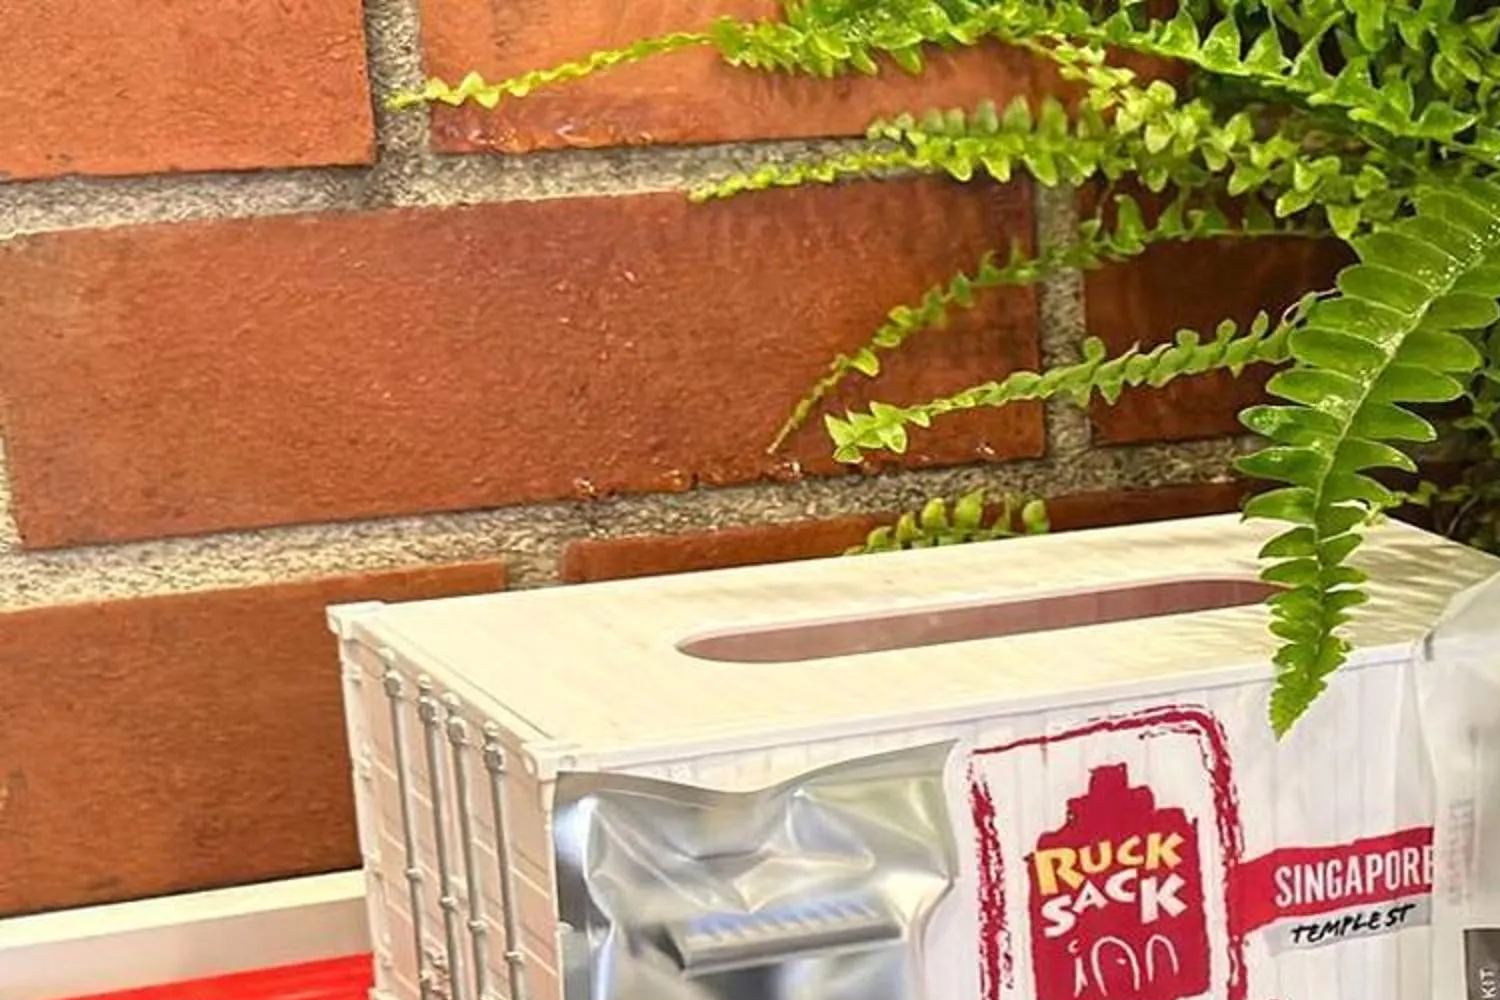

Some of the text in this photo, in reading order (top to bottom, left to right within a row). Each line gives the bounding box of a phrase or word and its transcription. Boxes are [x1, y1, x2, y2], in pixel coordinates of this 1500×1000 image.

[1034, 832, 1185, 896] RUCK
[1041, 868, 1188, 938] SACK
[1479, 967, 1497, 999] KIT
